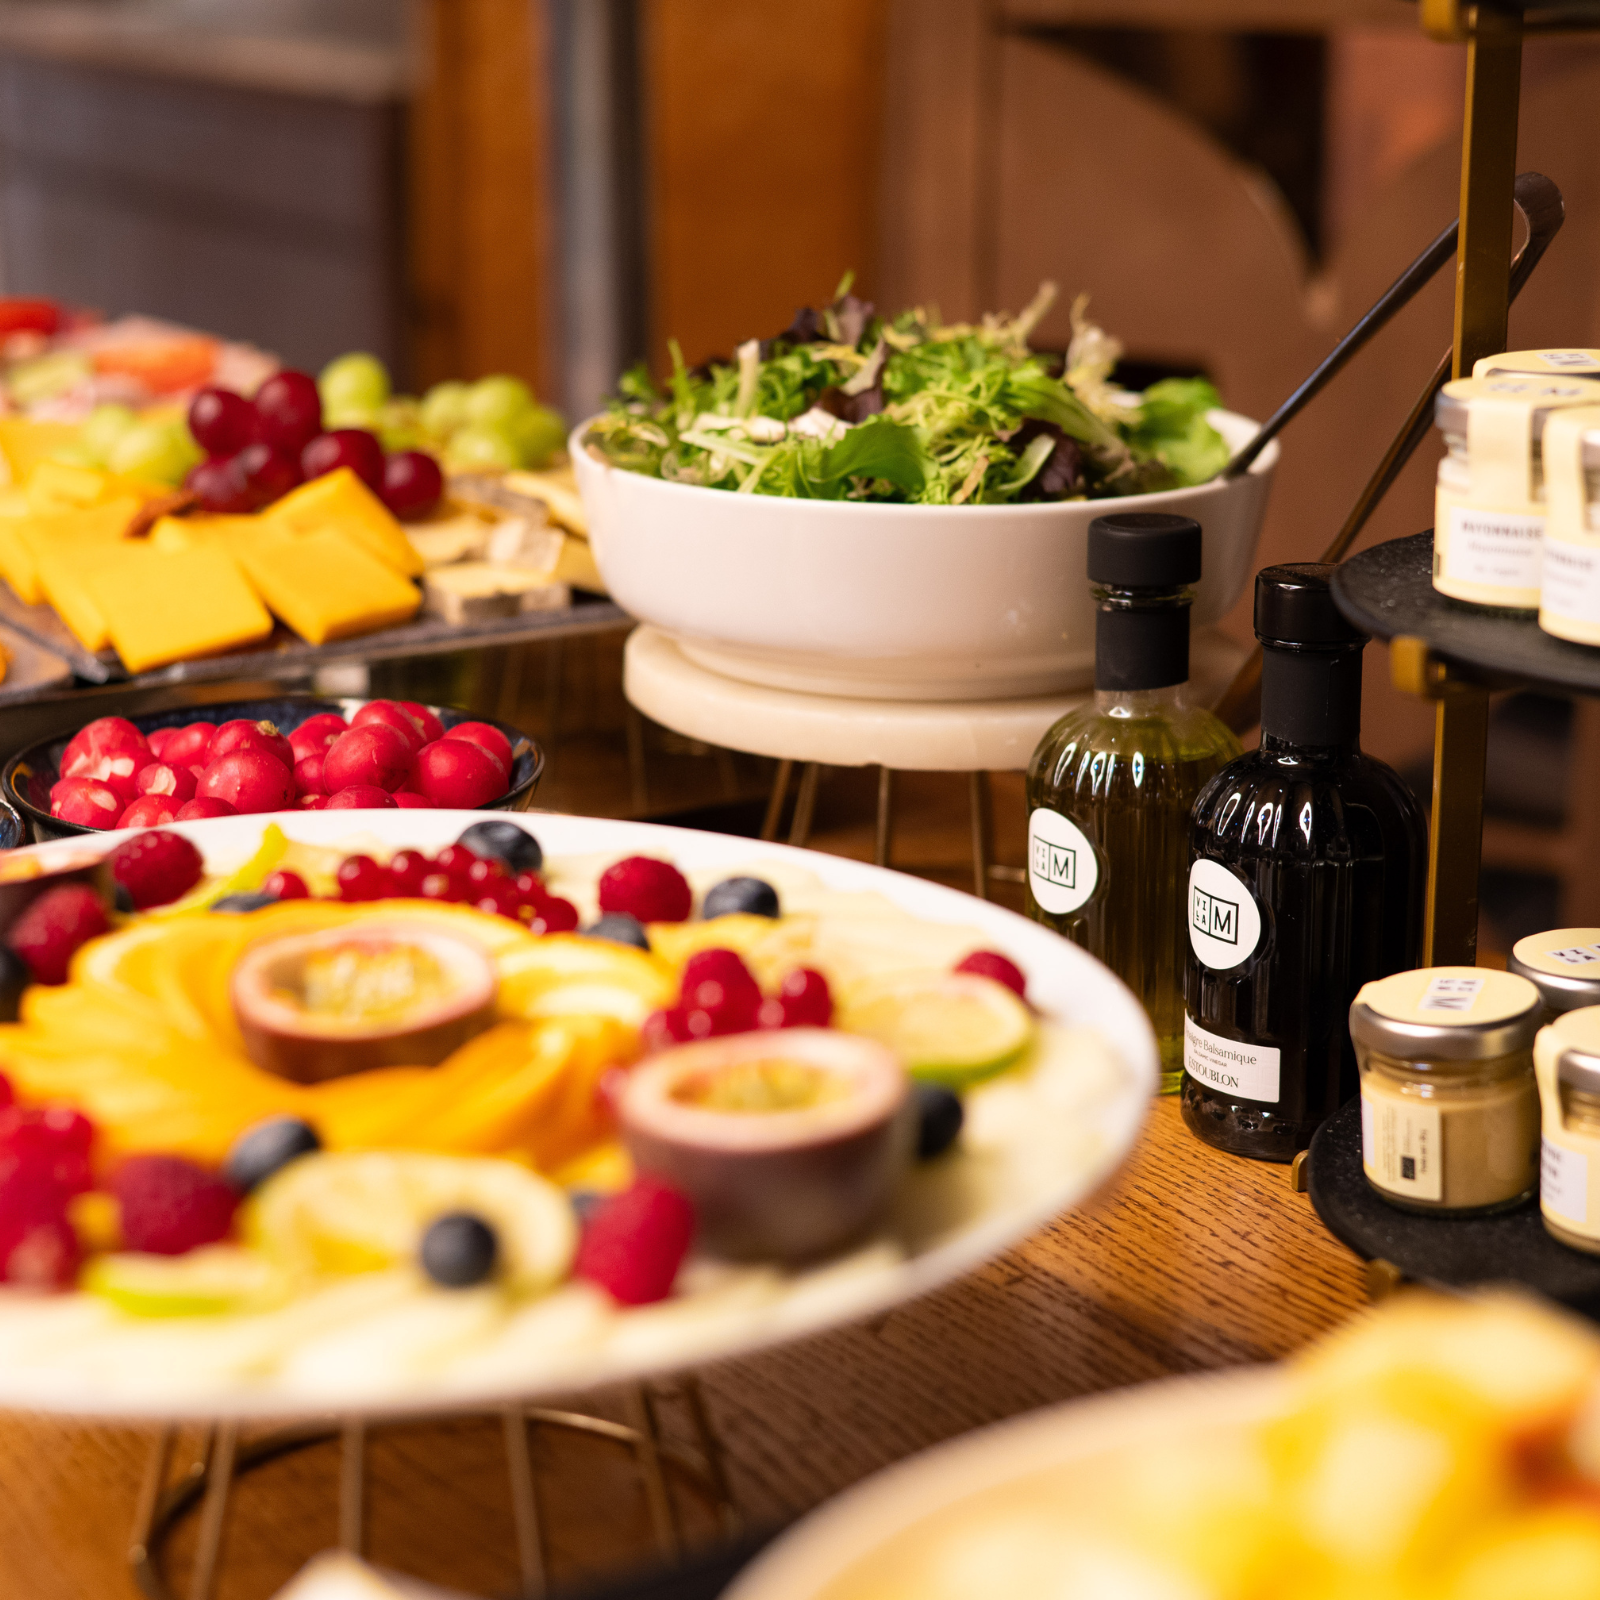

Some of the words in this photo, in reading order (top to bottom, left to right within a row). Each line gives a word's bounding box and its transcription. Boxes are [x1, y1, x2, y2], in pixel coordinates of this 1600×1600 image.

[1053, 852, 1069, 880] M
[1214, 905, 1231, 935] M
[1203, 1038, 1257, 1066] Balsamique
[1188, 1055, 1239, 1089] ESTOUBLON
